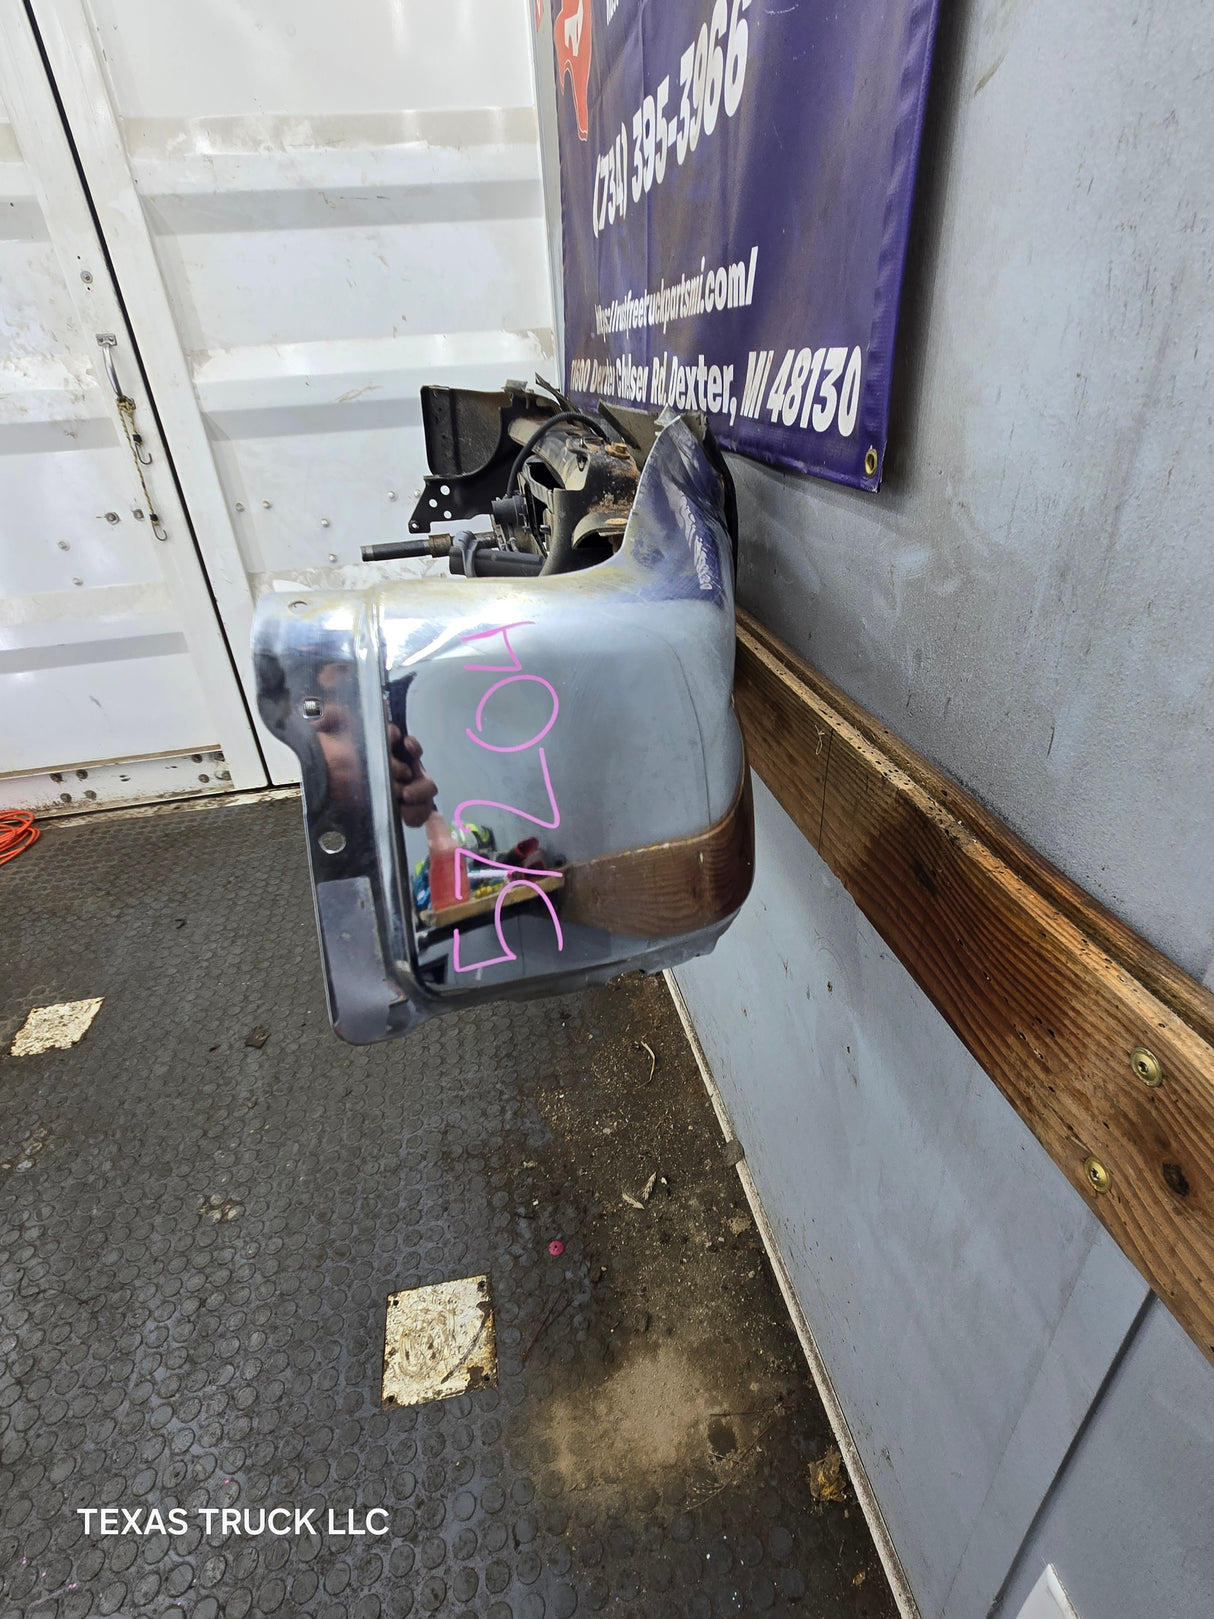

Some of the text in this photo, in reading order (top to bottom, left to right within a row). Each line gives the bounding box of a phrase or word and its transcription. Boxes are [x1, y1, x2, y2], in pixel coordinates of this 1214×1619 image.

[593, 0, 750, 239] (734) 395-3966
[668, 354, 737, 426] Dexter,
[740, 350, 774, 419] MI
[766, 346, 862, 437] 48130
[453, 620, 564, 973] 57204
